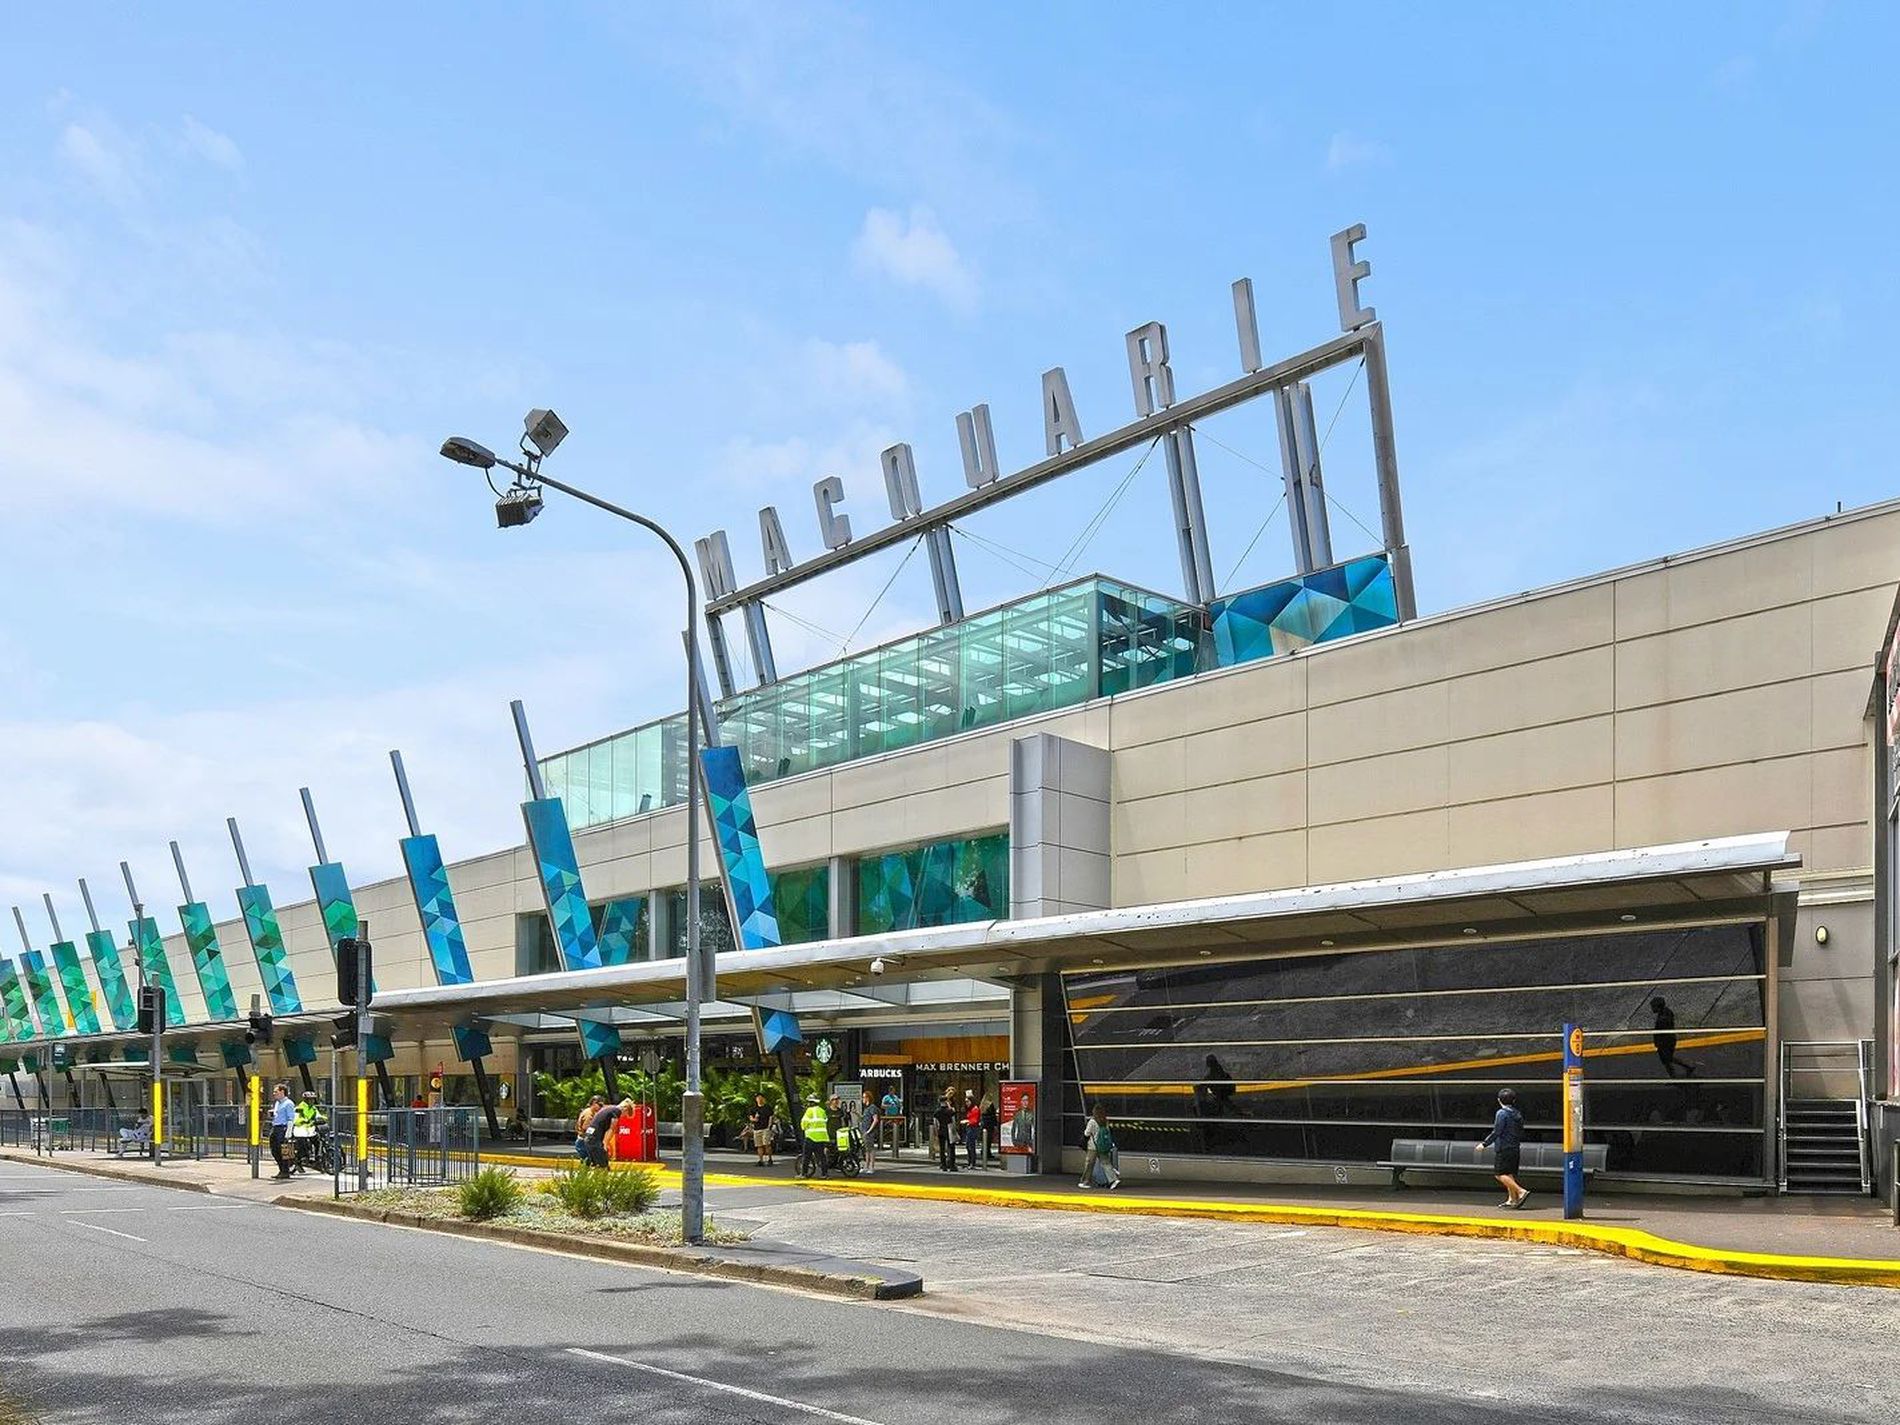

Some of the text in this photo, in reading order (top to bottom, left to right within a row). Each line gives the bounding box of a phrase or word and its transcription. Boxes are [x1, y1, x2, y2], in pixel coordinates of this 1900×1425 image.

[695, 223, 1376, 601] MACQUARIE
[915, 1062, 937, 1072] MAX
[939, 1062, 991, 1072] BRENNER
[859, 1068, 903, 1078] ARBUCKS
